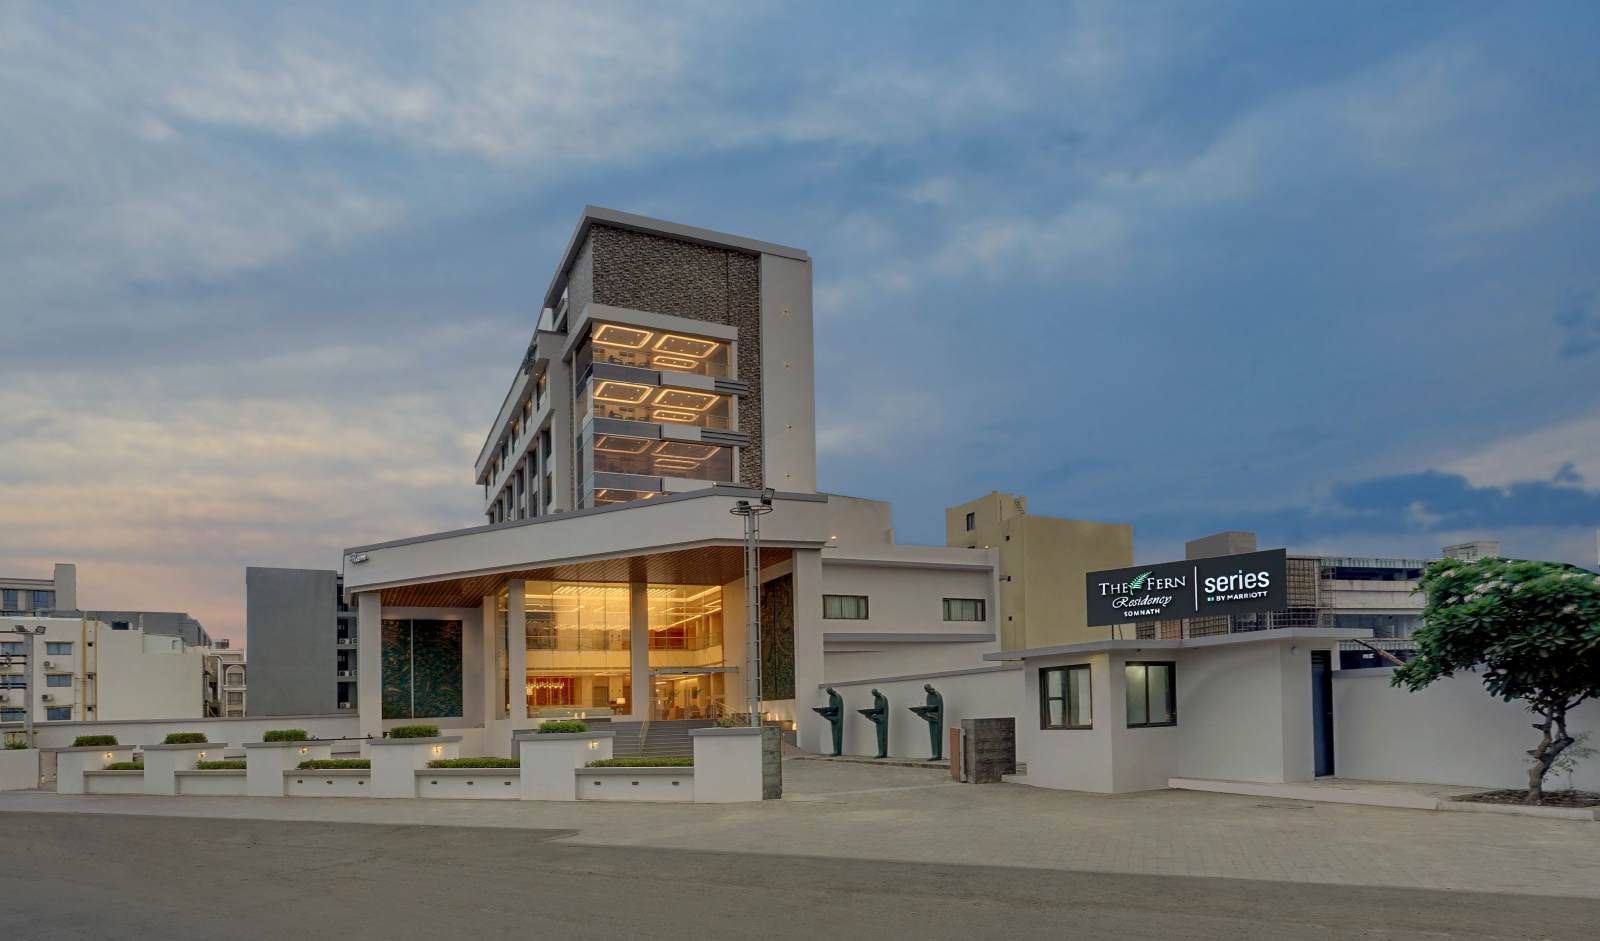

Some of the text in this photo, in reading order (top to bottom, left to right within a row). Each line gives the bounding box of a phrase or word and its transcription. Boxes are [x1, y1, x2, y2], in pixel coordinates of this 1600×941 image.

[1098, 576, 1186, 596] THE FERN
[1204, 569, 1270, 594] series
[1112, 594, 1172, 609] Residency
[1227, 591, 1268, 601] MARRIOTT
[1124, 608, 1161, 617] SOMNATH
